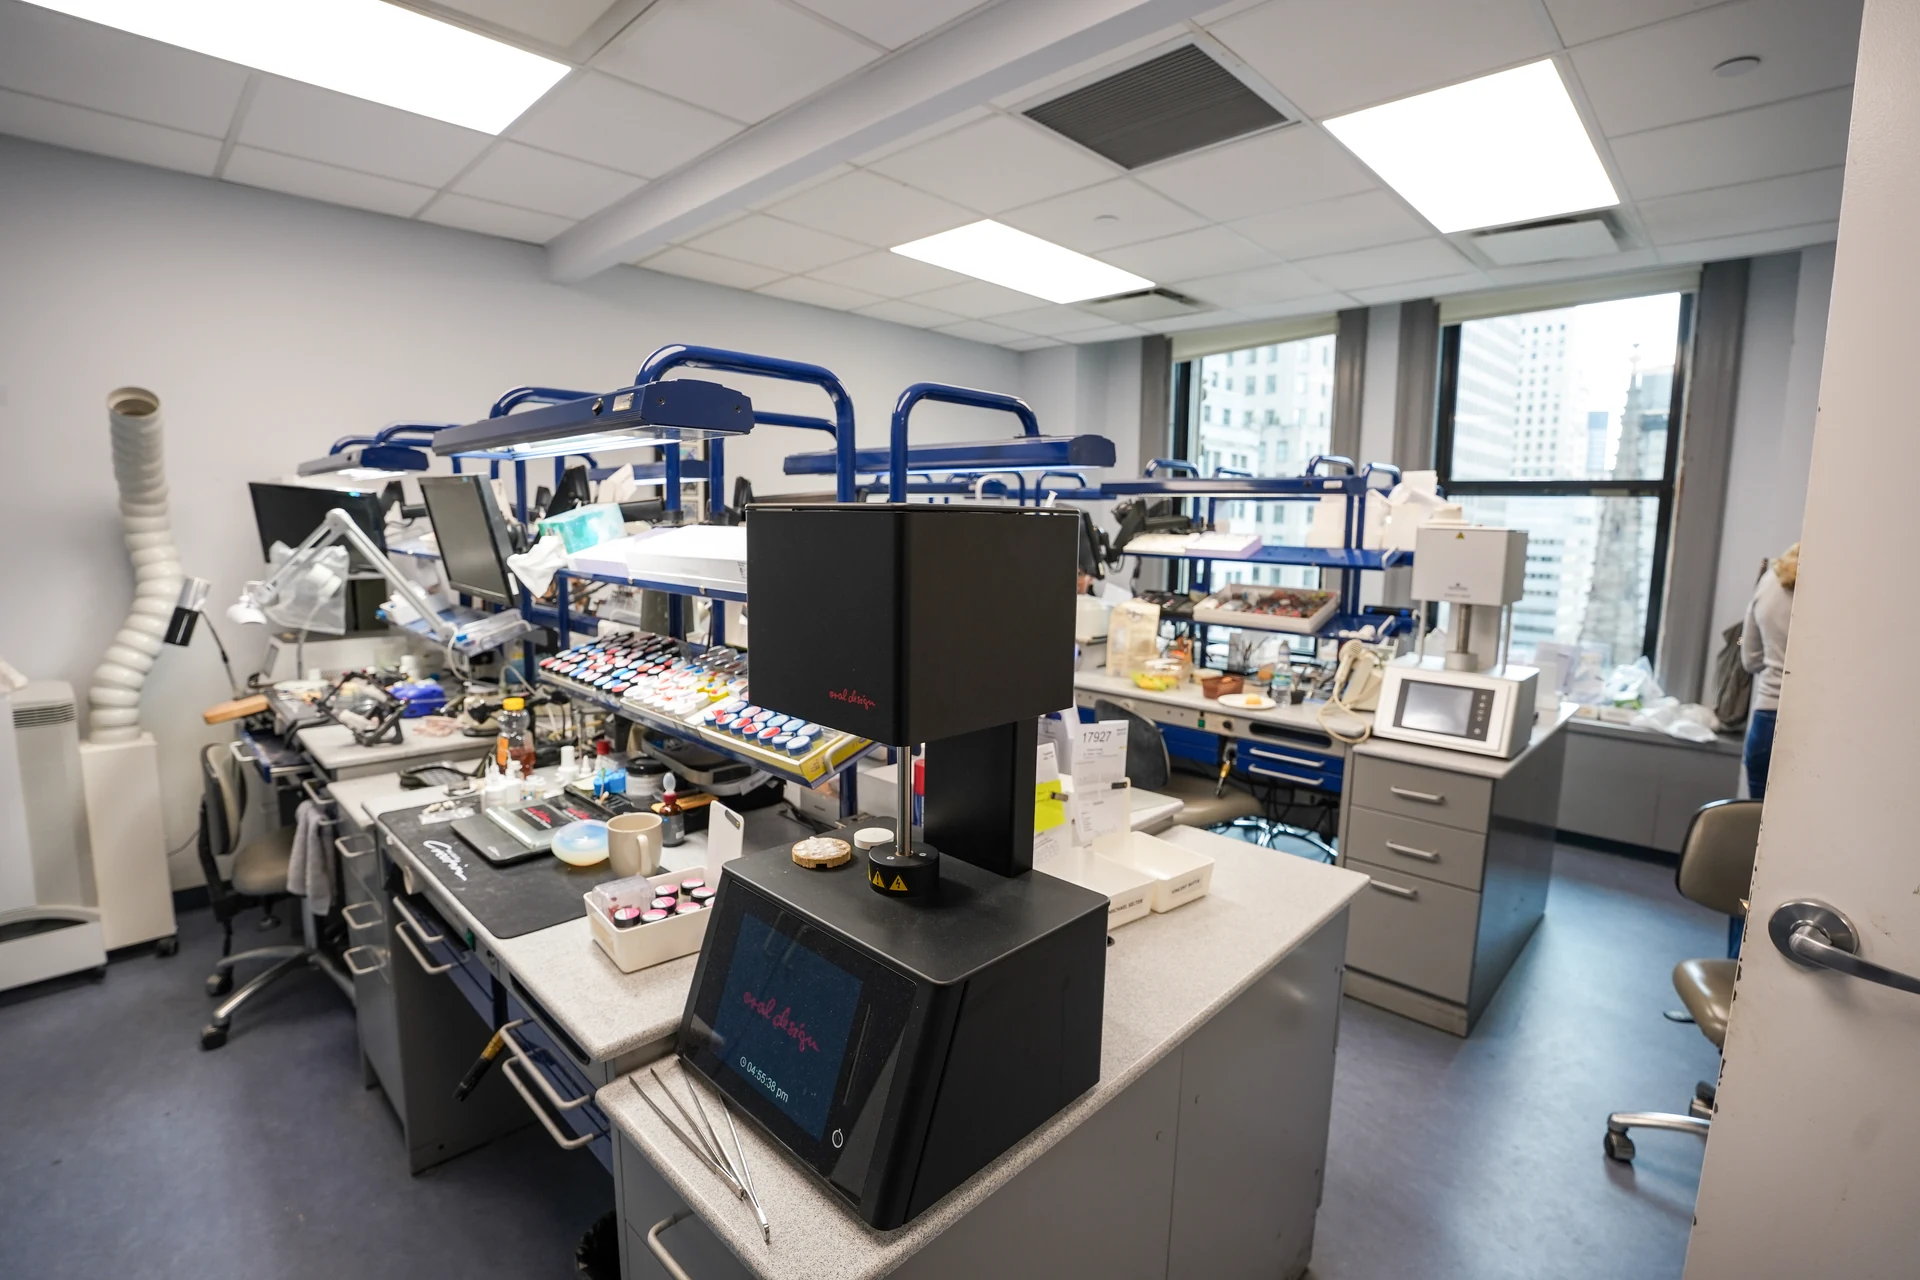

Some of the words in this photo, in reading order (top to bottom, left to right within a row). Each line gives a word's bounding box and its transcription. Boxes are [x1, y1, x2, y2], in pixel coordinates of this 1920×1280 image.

[829, 688, 847, 701] oral
[848, 689, 876, 710] design
[1083, 731, 1112, 743] 17927
[743, 991, 776, 1019] oral
[772, 1006, 820, 1052] design
[746, 1061, 776, 1092] 04:55:38
[776, 1087, 789, 1103] pm
